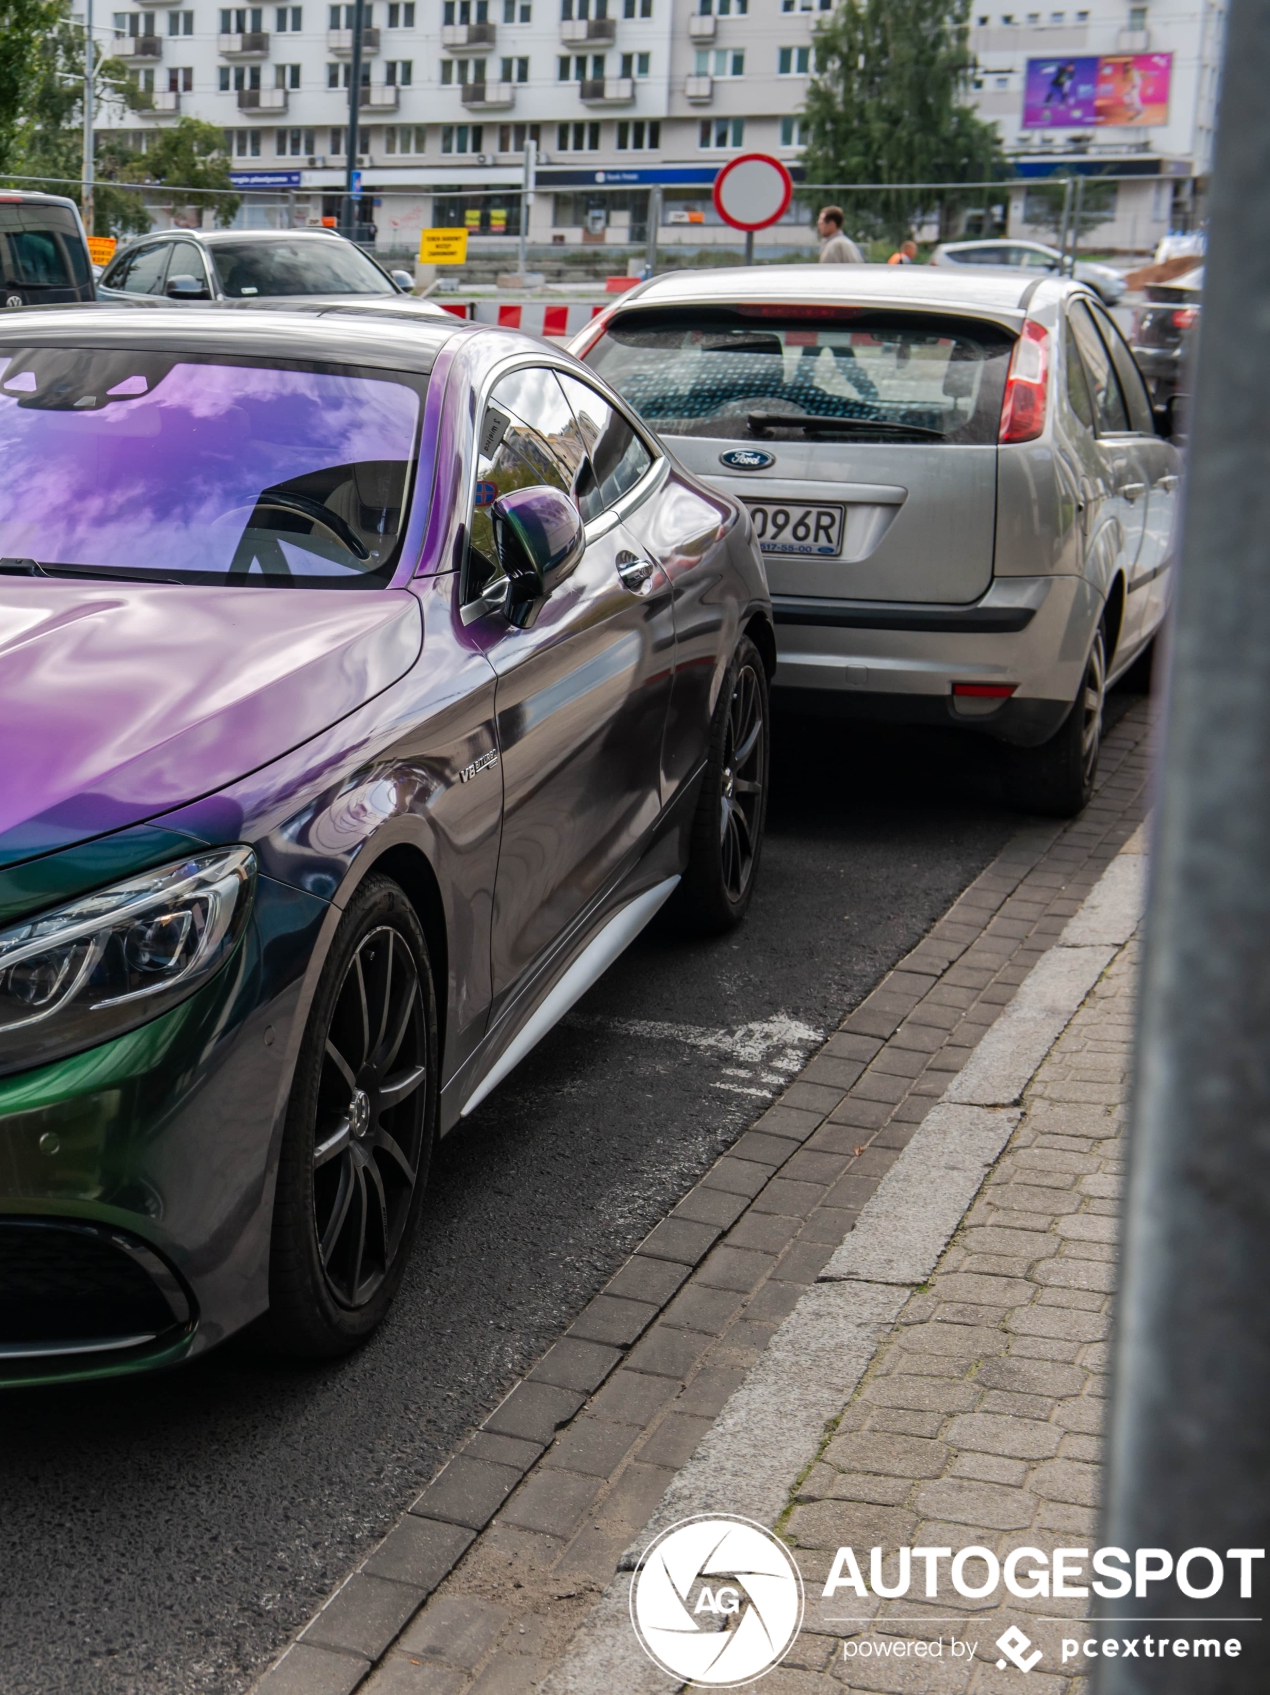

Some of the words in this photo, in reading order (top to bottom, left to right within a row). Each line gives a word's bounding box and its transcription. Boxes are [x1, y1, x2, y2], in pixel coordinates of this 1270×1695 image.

[731, 451, 761, 466] Ford
[751, 507, 835, 543] 096R
[460, 763, 476, 783] V8
